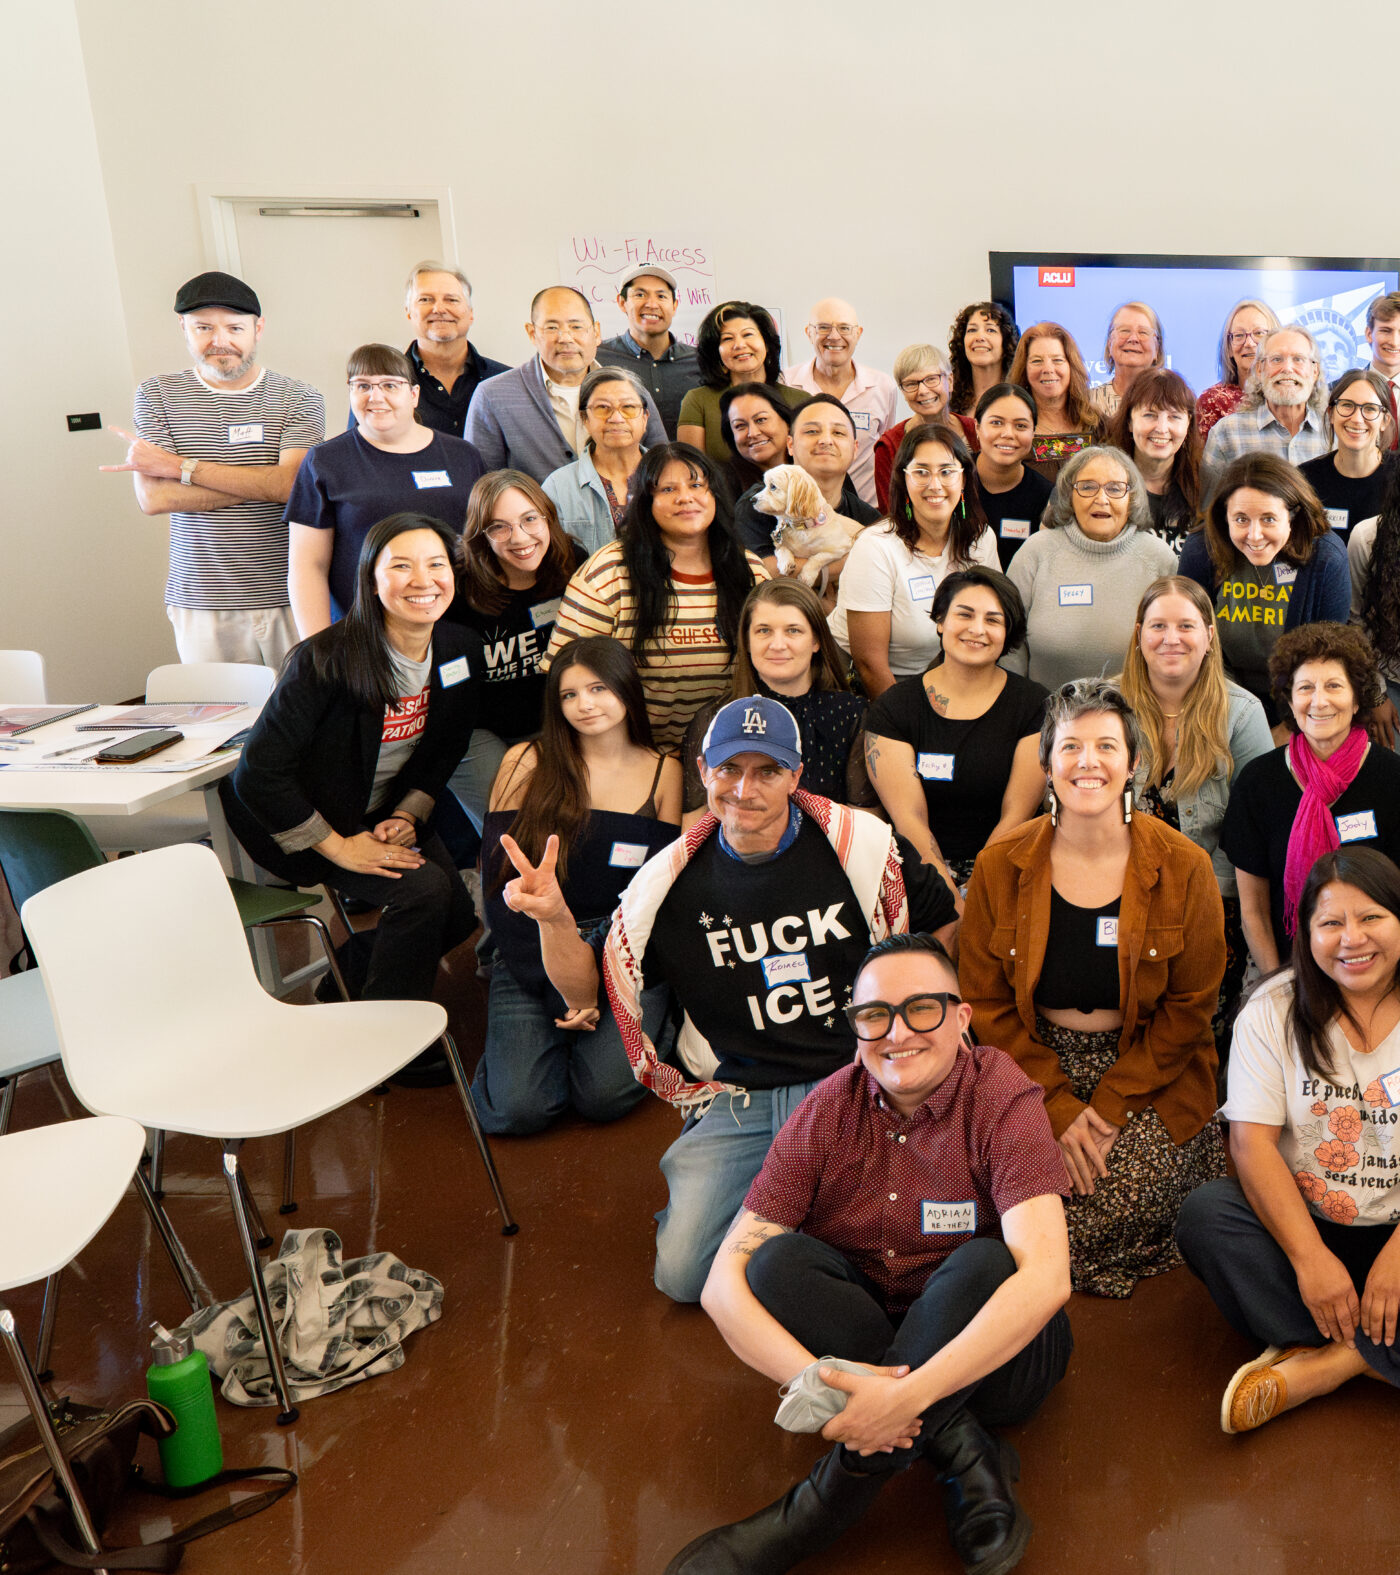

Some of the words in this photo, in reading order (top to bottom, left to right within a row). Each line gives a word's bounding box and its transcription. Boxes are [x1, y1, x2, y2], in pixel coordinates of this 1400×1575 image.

[646, 238, 706, 266] Access
[1042, 271, 1072, 284] ACLU
[1222, 581, 1259, 600] POD
[1216, 603, 1285, 626] AMERI
[670, 627, 722, 645] GUESS
[483, 628, 539, 669] WE
[486, 661, 519, 680] THE
[741, 707, 768, 735] LA
[705, 901, 852, 968] FUCK
[765, 959, 806, 975] ROMEO
[746, 975, 837, 1031] ICE
[1302, 1079, 1320, 1097] El
[1324, 1169, 1358, 1187] será
[926, 1208, 973, 1220] ADRIAN
